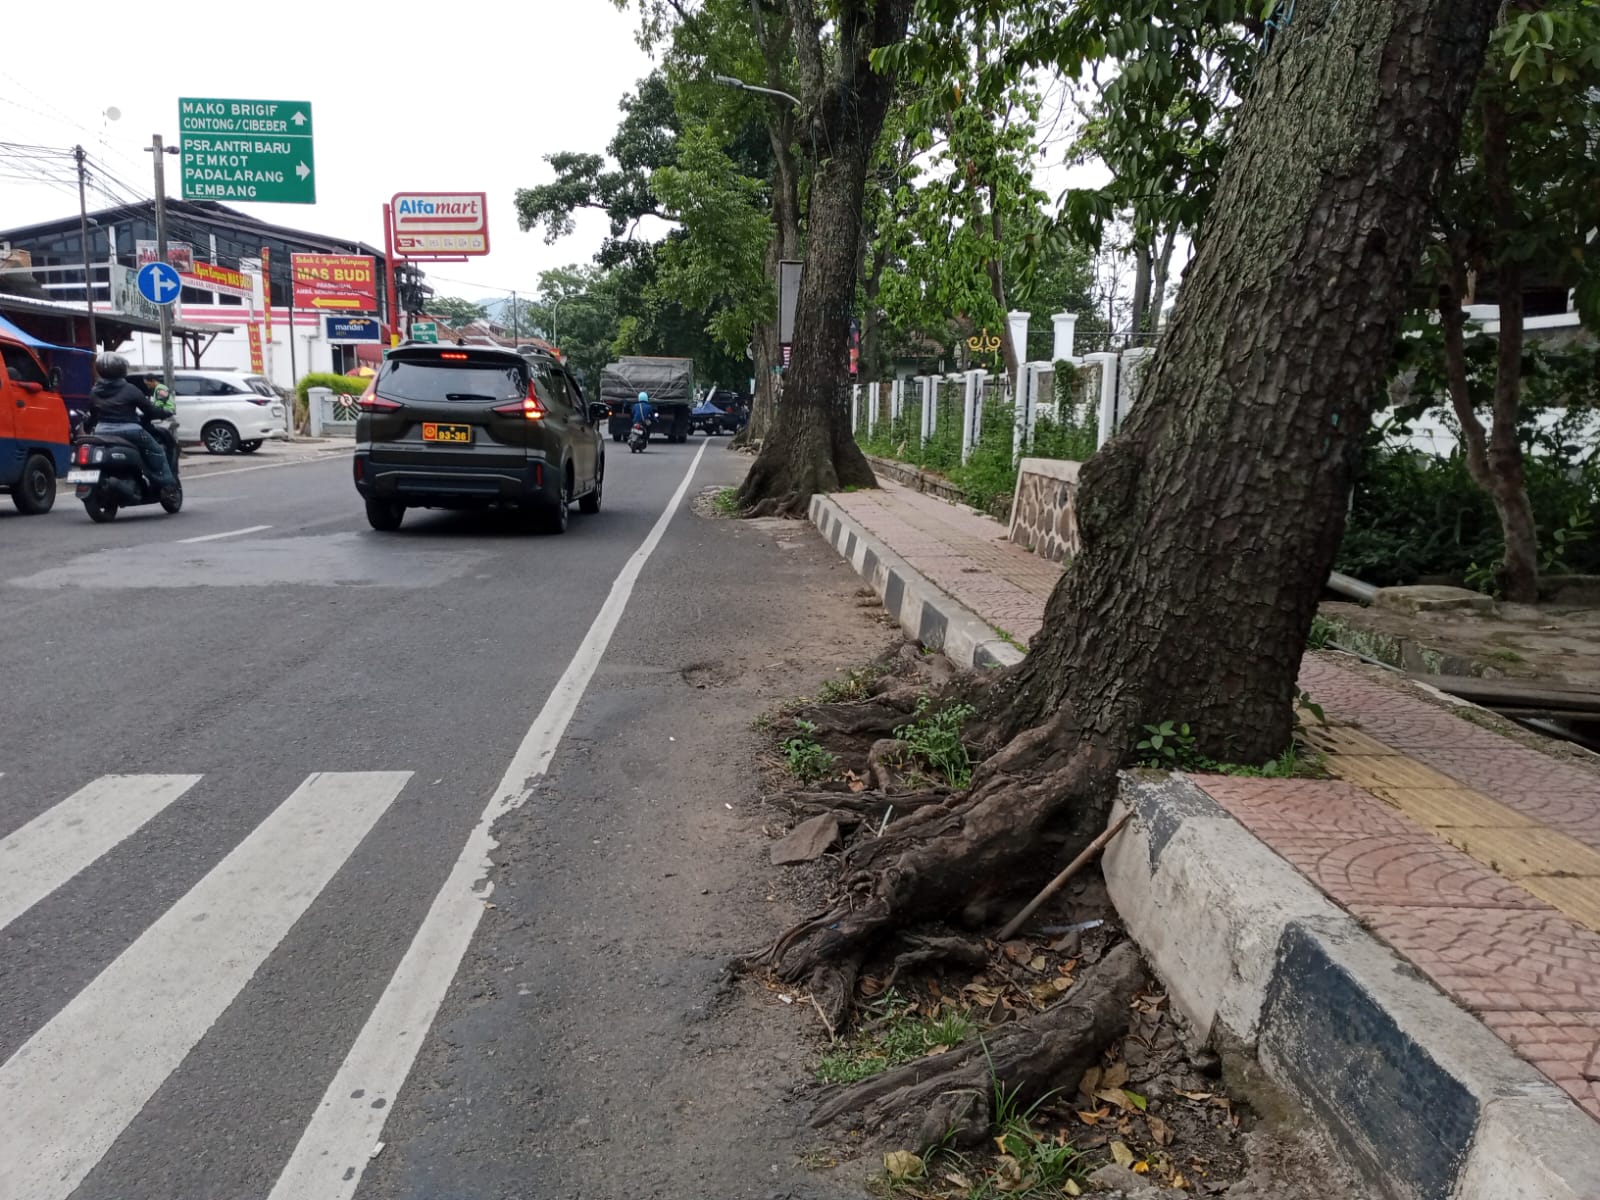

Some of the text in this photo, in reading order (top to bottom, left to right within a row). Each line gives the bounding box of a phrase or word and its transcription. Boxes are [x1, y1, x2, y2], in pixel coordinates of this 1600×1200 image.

[183, 102, 278, 116] MAKO BRIGIF
[183, 117, 287, 132] CONTONG/CIBEBER
[184, 139, 291, 154] PSR.ANTRI BARU
[184, 153, 248, 167] PEMKOT
[185, 168, 284, 183] PADALARANG
[186, 183, 257, 197] LEMBANG
[399, 200, 478, 214] Alfamart
[297, 267, 371, 282] MAS BUDI
